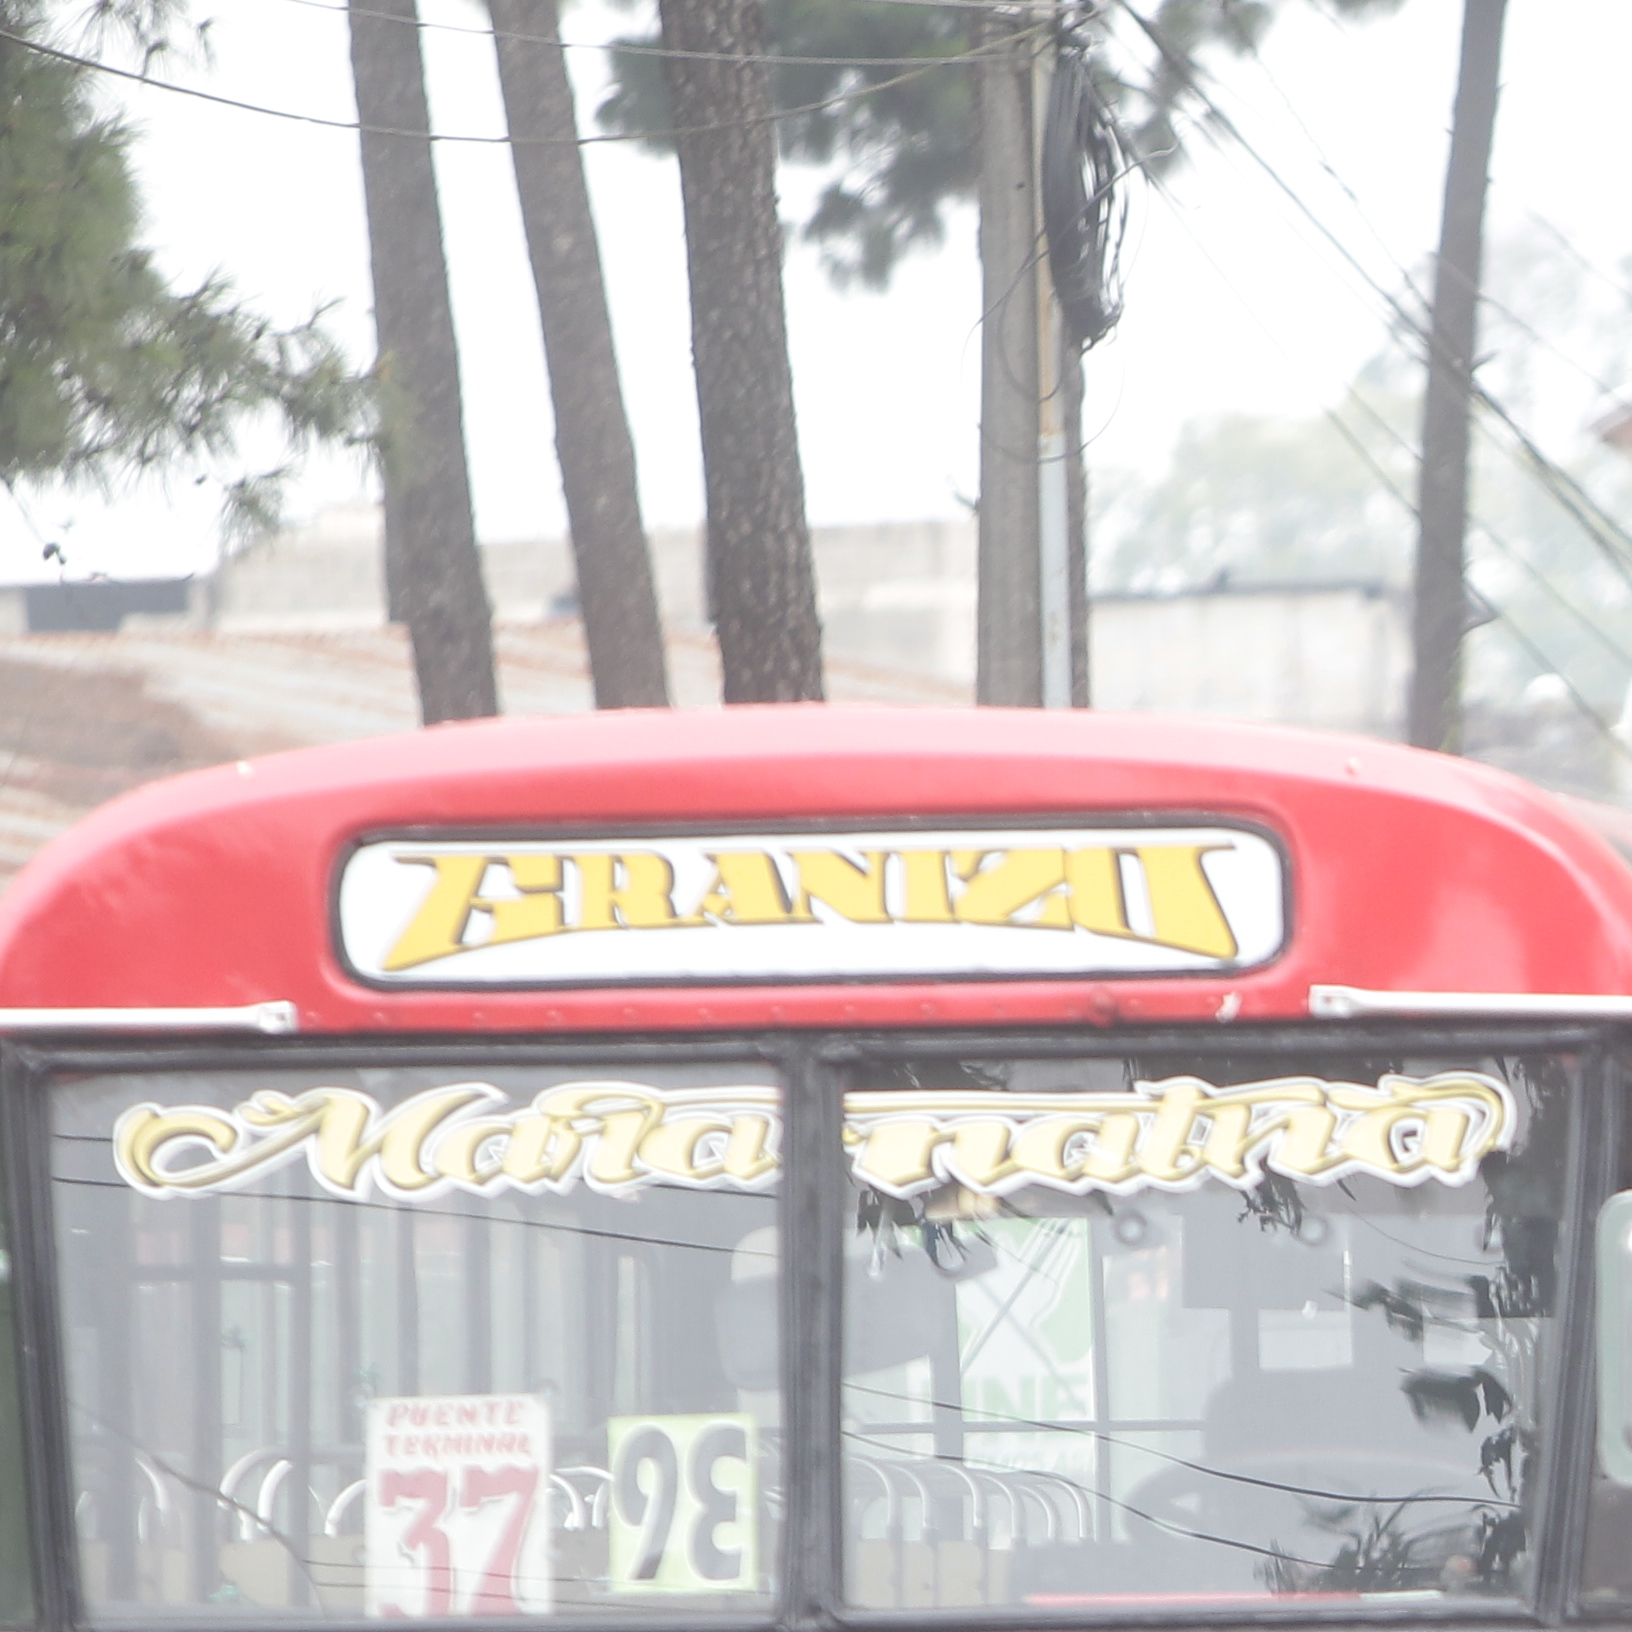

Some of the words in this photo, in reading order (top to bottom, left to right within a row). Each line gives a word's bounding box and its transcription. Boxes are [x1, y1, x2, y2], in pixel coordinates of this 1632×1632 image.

[384, 843, 1239, 972] GRANIZO
[382, 1432, 532, 1461] TERMINAL
[386, 1400, 527, 1427] PUENTE
[379, 1463, 540, 1618] 37
